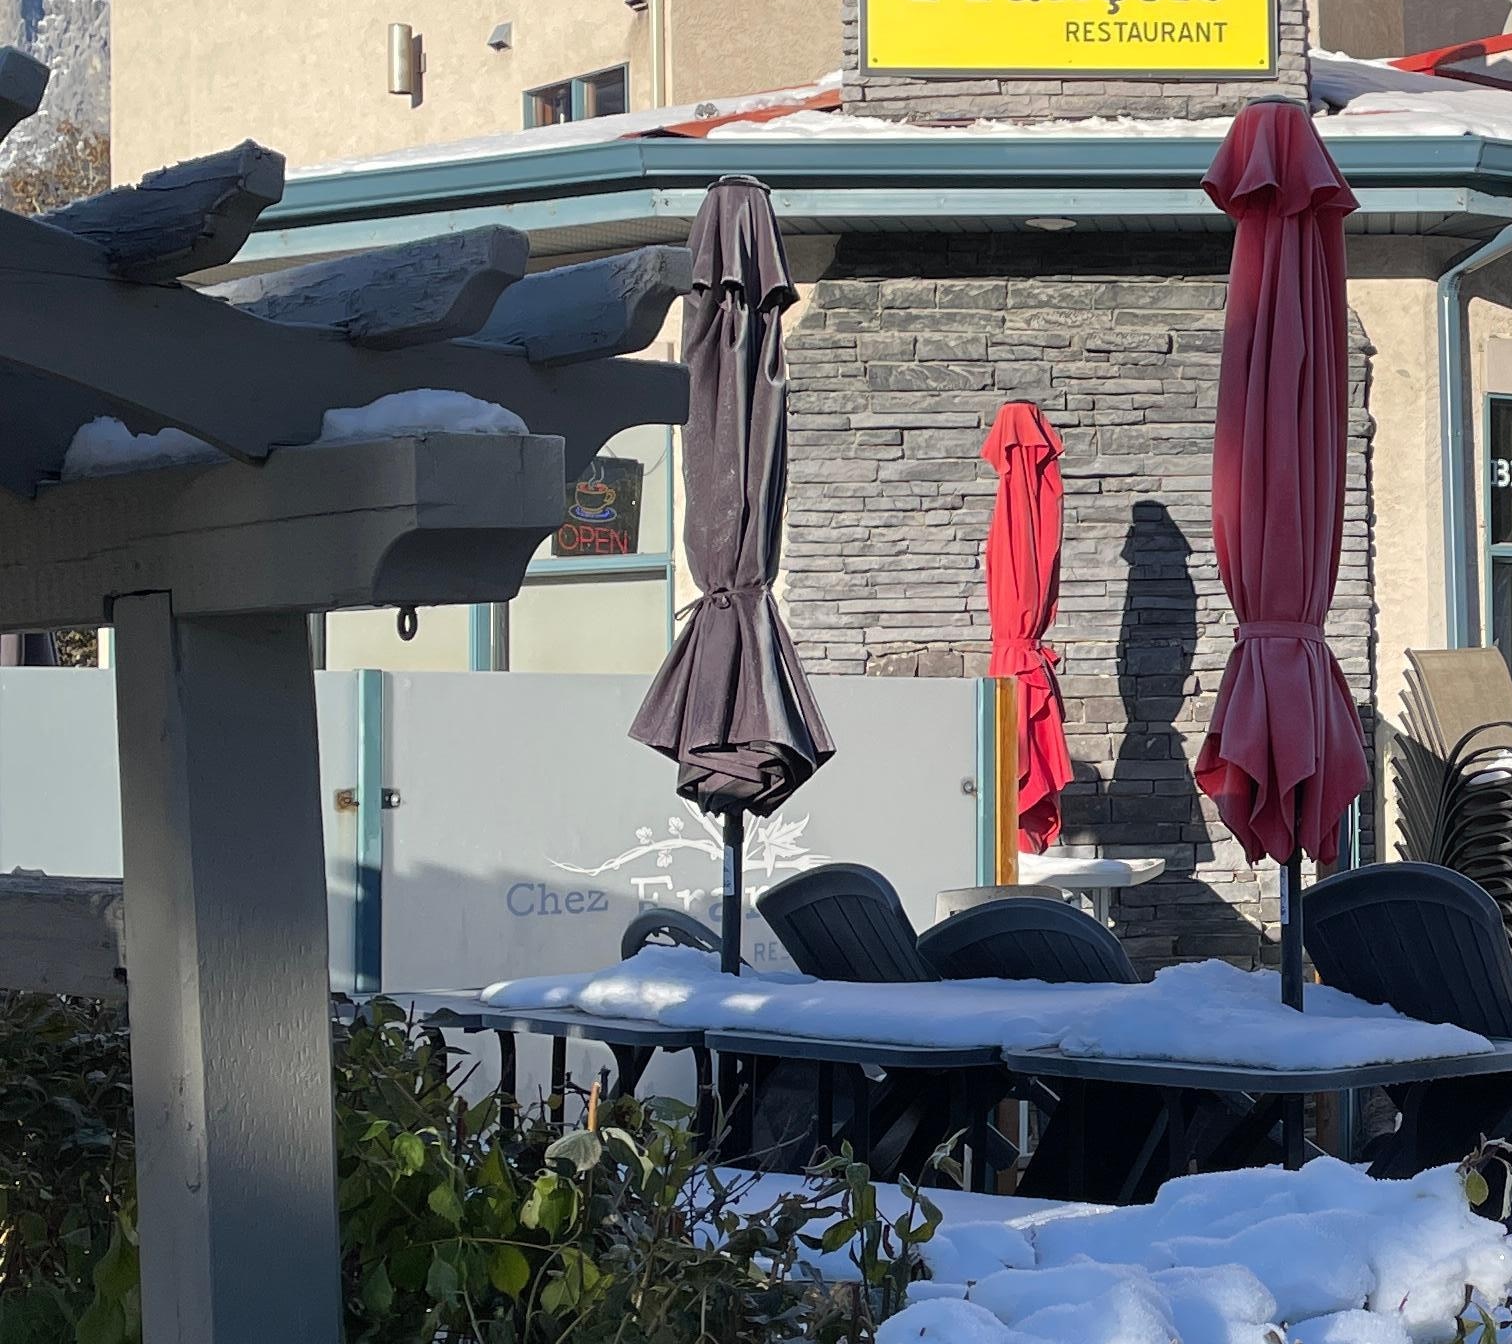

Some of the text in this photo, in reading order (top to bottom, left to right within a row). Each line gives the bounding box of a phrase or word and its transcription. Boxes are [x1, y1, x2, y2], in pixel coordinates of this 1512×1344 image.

[1065, 21, 1229, 44] RESTAURANT
[556, 523, 629, 555] OPEN
[505, 882, 610, 918] Chez
